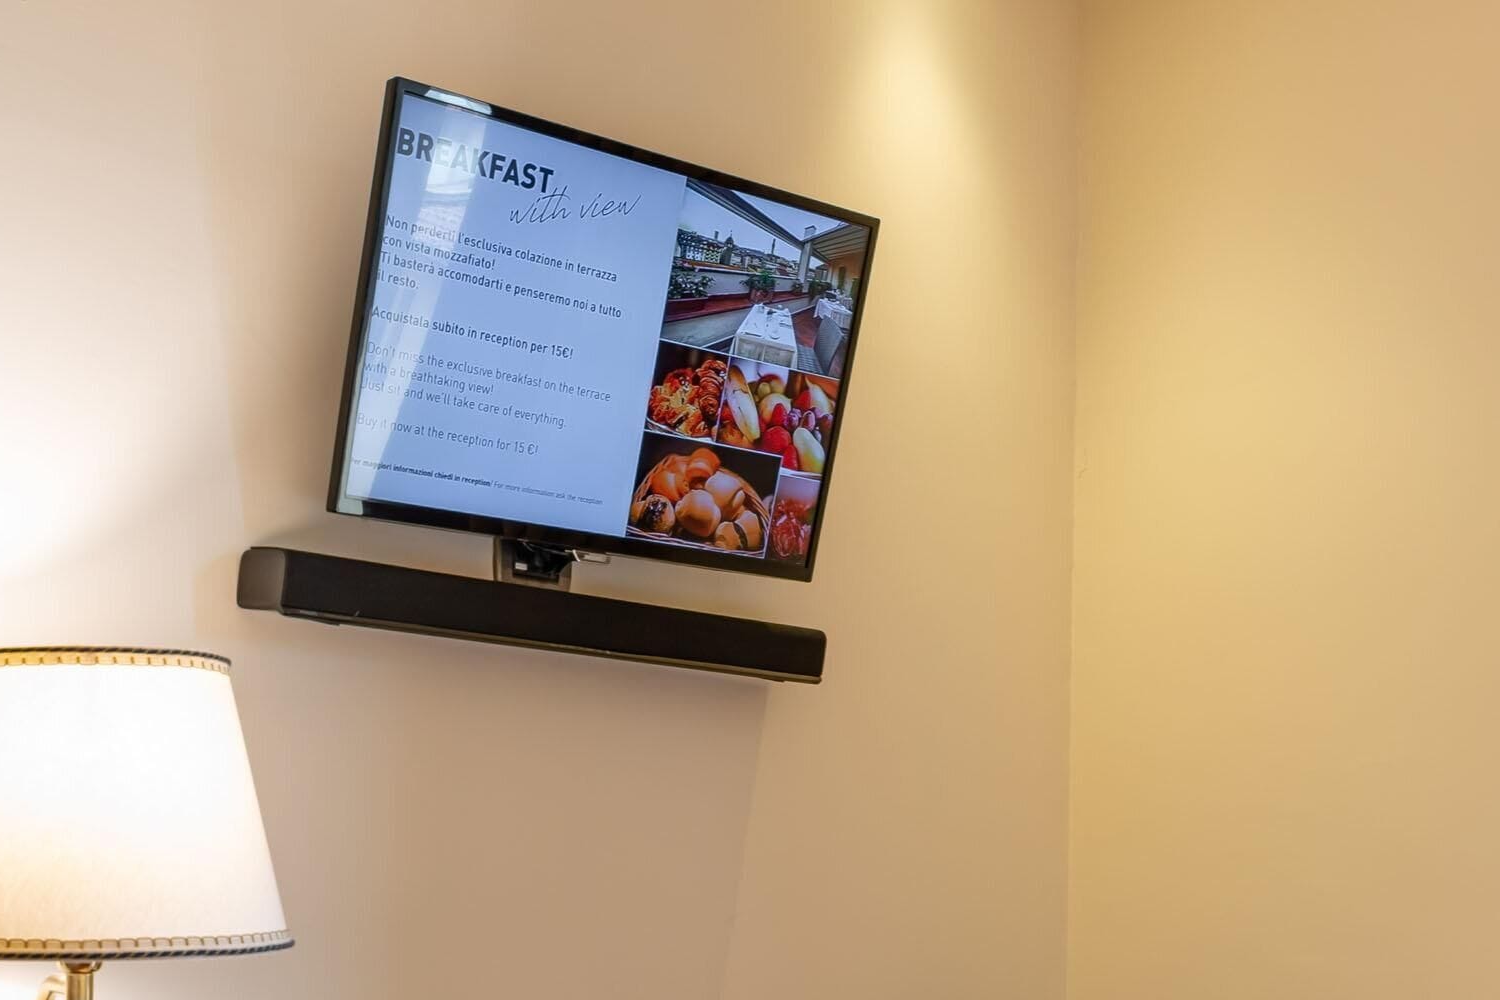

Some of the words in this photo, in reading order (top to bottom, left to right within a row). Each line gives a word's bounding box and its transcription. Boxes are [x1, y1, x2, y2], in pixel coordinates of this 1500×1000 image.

[396, 127, 555, 194] BREAKFAST
[509, 185, 572, 224] with
[580, 192, 642, 219] view
[383, 235, 401, 248] con
[405, 240, 430, 255] vista
[433, 248, 496, 270] mozzafiato!
[385, 215, 408, 231] Non
[410, 223, 456, 241] perderti
[457, 232, 512, 256] l'esclusiva
[515, 249, 562, 268] colazione
[565, 259, 574, 271] in
[577, 263, 617, 282] terrazza
[381, 251, 390, 264] Ti
[438, 267, 503, 290] accomodarti
[505, 283, 511, 292] e
[514, 285, 571, 306] penseremo
[573, 299, 588, 310] noi
[591, 303, 596, 312] a
[599, 303, 621, 318] tutto
[372, 305, 429, 328] Acquistala
[432, 320, 465, 336] subito
[467, 326, 477, 339] in
[480, 331, 528, 350] reception
[530, 342, 548, 354] per
[551, 344, 573, 359] 15€!
[365, 361, 387, 374] with
[390, 368, 396, 376] a
[400, 366, 466, 393] breathtaking
[468, 382, 494, 396] view!
[367, 342, 395, 357] Don't
[398, 351, 424, 363] miss
[427, 354, 443, 367] the
[447, 360, 493, 377] exclusive
[495, 368, 542, 388] breakfast
[544, 380, 556, 391] on
[559, 381, 574, 394] the
[577, 386, 611, 401] terrace
[361, 377, 385, 392] Just
[387, 384, 400, 395] sit
[404, 388, 423, 400] and
[426, 392, 450, 405] we'll
[453, 396, 475, 410] take
[478, 402, 499, 414] care
[502, 405, 513, 416] of
[514, 409, 566, 429] everything.
[357, 412, 378, 430] Buy
[391, 421, 412, 433] now
[414, 424, 425, 436] at
[427, 426, 444, 439] the
[447, 431, 493, 448] reception
[496, 438, 511, 450] for
[514, 441, 524, 453] 15
[393, 463, 433, 477] informazioni
